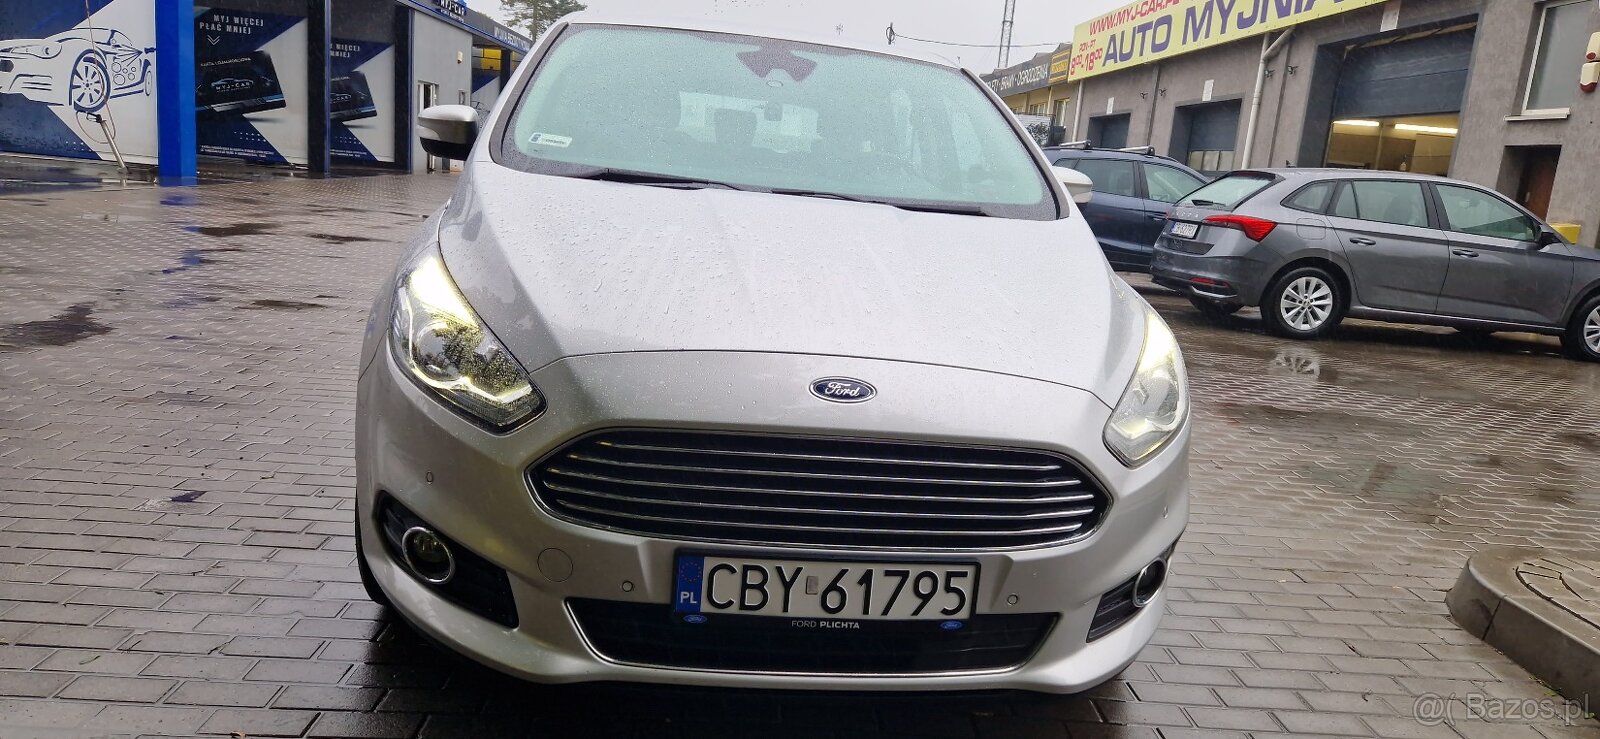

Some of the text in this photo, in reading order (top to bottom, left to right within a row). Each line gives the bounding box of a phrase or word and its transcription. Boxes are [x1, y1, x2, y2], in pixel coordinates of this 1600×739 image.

[213, 14, 264, 27] MYJ WIĘCEJ
[200, 21, 251, 35] PŁAĆ MNIEJ
[1102, 0, 1316, 67] AUTO MYJ
[335, 43, 360, 52] WIĘCEJ
[825, 382, 861, 397] Ford
[680, 590, 698, 604] PL
[706, 563, 969, 617] CBY 61795
[791, 620, 860, 630] FORD PLICHTA
